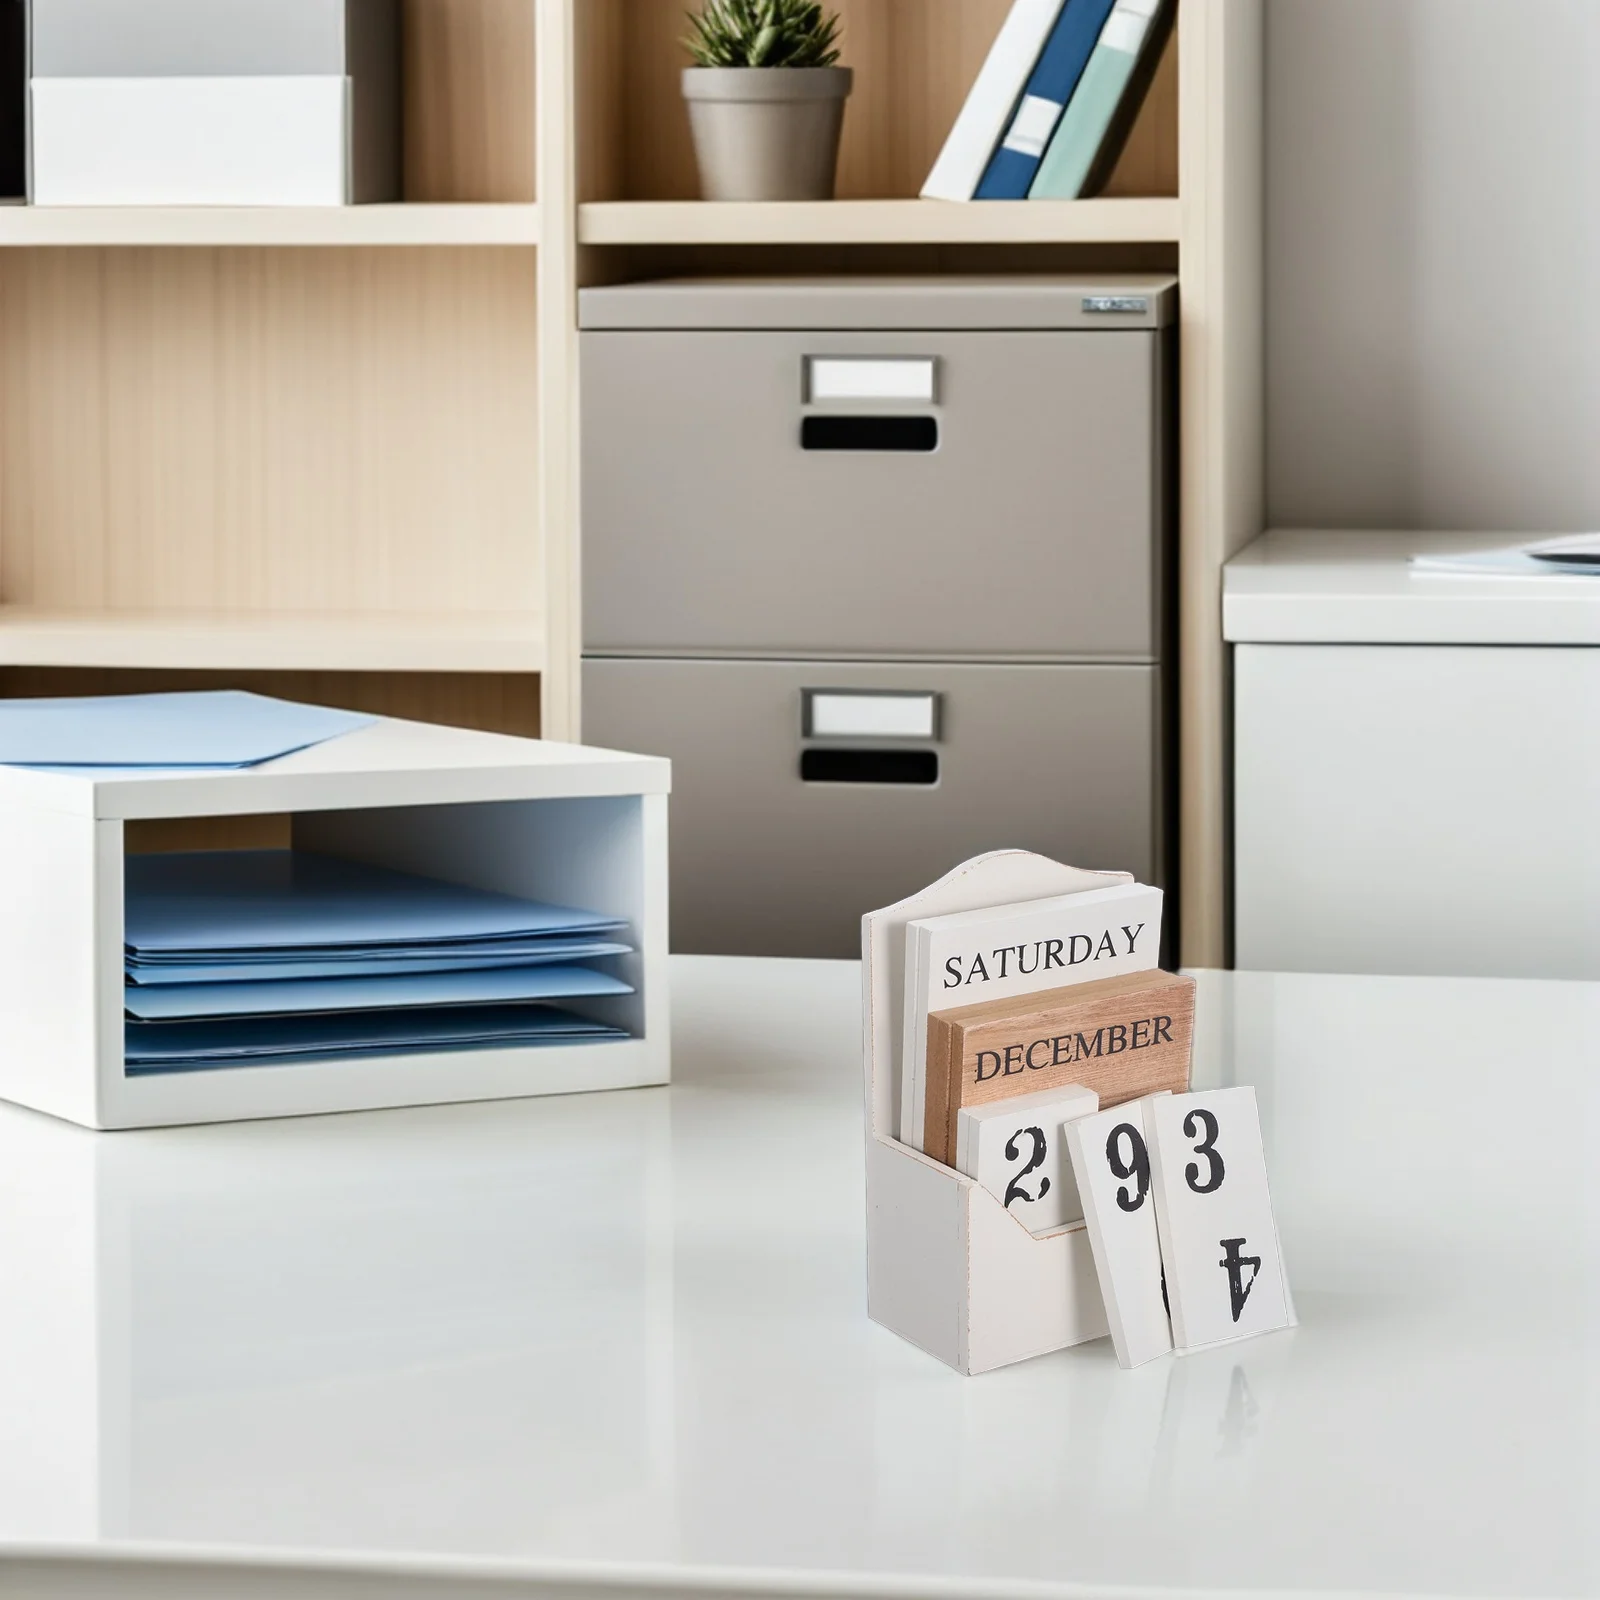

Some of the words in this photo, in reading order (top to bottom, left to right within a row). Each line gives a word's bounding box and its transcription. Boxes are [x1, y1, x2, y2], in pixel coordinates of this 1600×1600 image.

[943, 923, 1145, 989] SATURDAY
[975, 1016, 1174, 1083] DECEMBER
[1004, 1126, 1050, 1208] 2
[1105, 1123, 1150, 1212] 9
[1184, 1109, 1226, 1194] 3
[1219, 1238, 1261, 1322] 4
